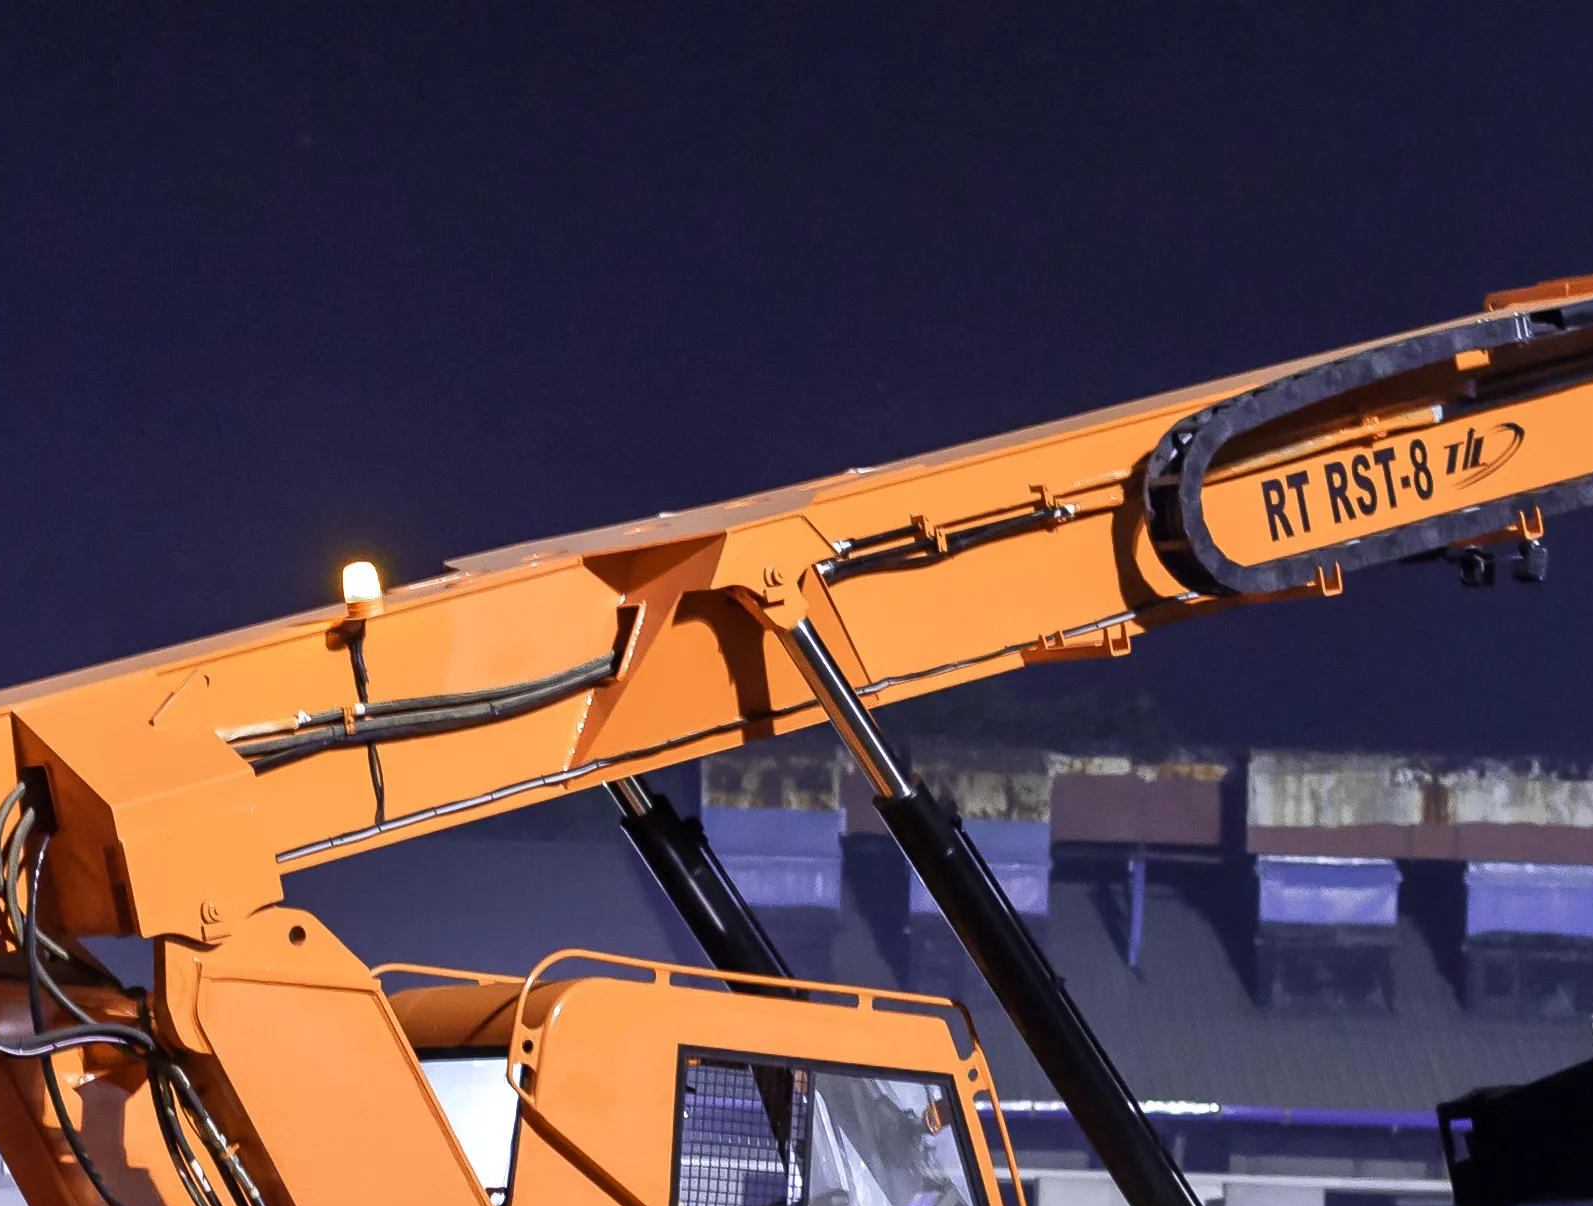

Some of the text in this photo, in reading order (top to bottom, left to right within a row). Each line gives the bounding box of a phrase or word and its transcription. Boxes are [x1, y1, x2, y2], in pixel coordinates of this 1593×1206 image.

[1444, 428, 1490, 476] TIL
[1261, 439, 1433, 542] RT RST-8
